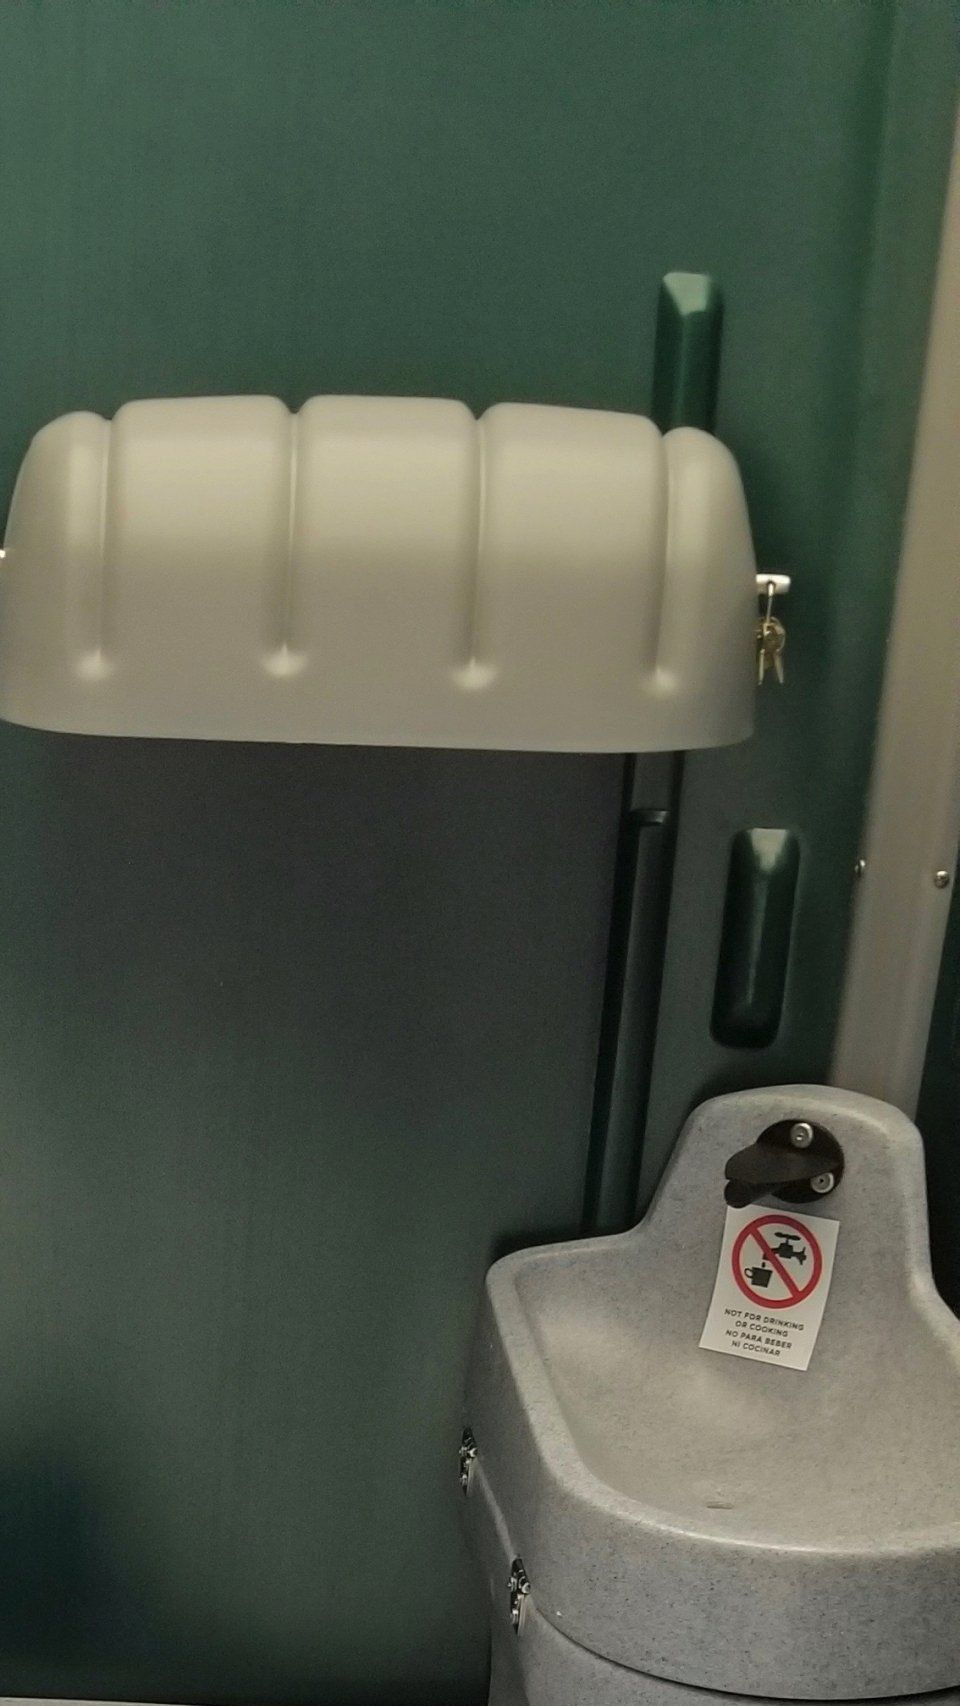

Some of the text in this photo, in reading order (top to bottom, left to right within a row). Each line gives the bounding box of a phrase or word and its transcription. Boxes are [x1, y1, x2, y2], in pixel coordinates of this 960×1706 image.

[724, 1309, 804, 1331] NOT FOR DRINKING
[735, 1320, 788, 1337] OR COOKING
[726, 1330, 792, 1349] NO PARA BEBER
[743, 1343, 781, 1356] COCINAR
